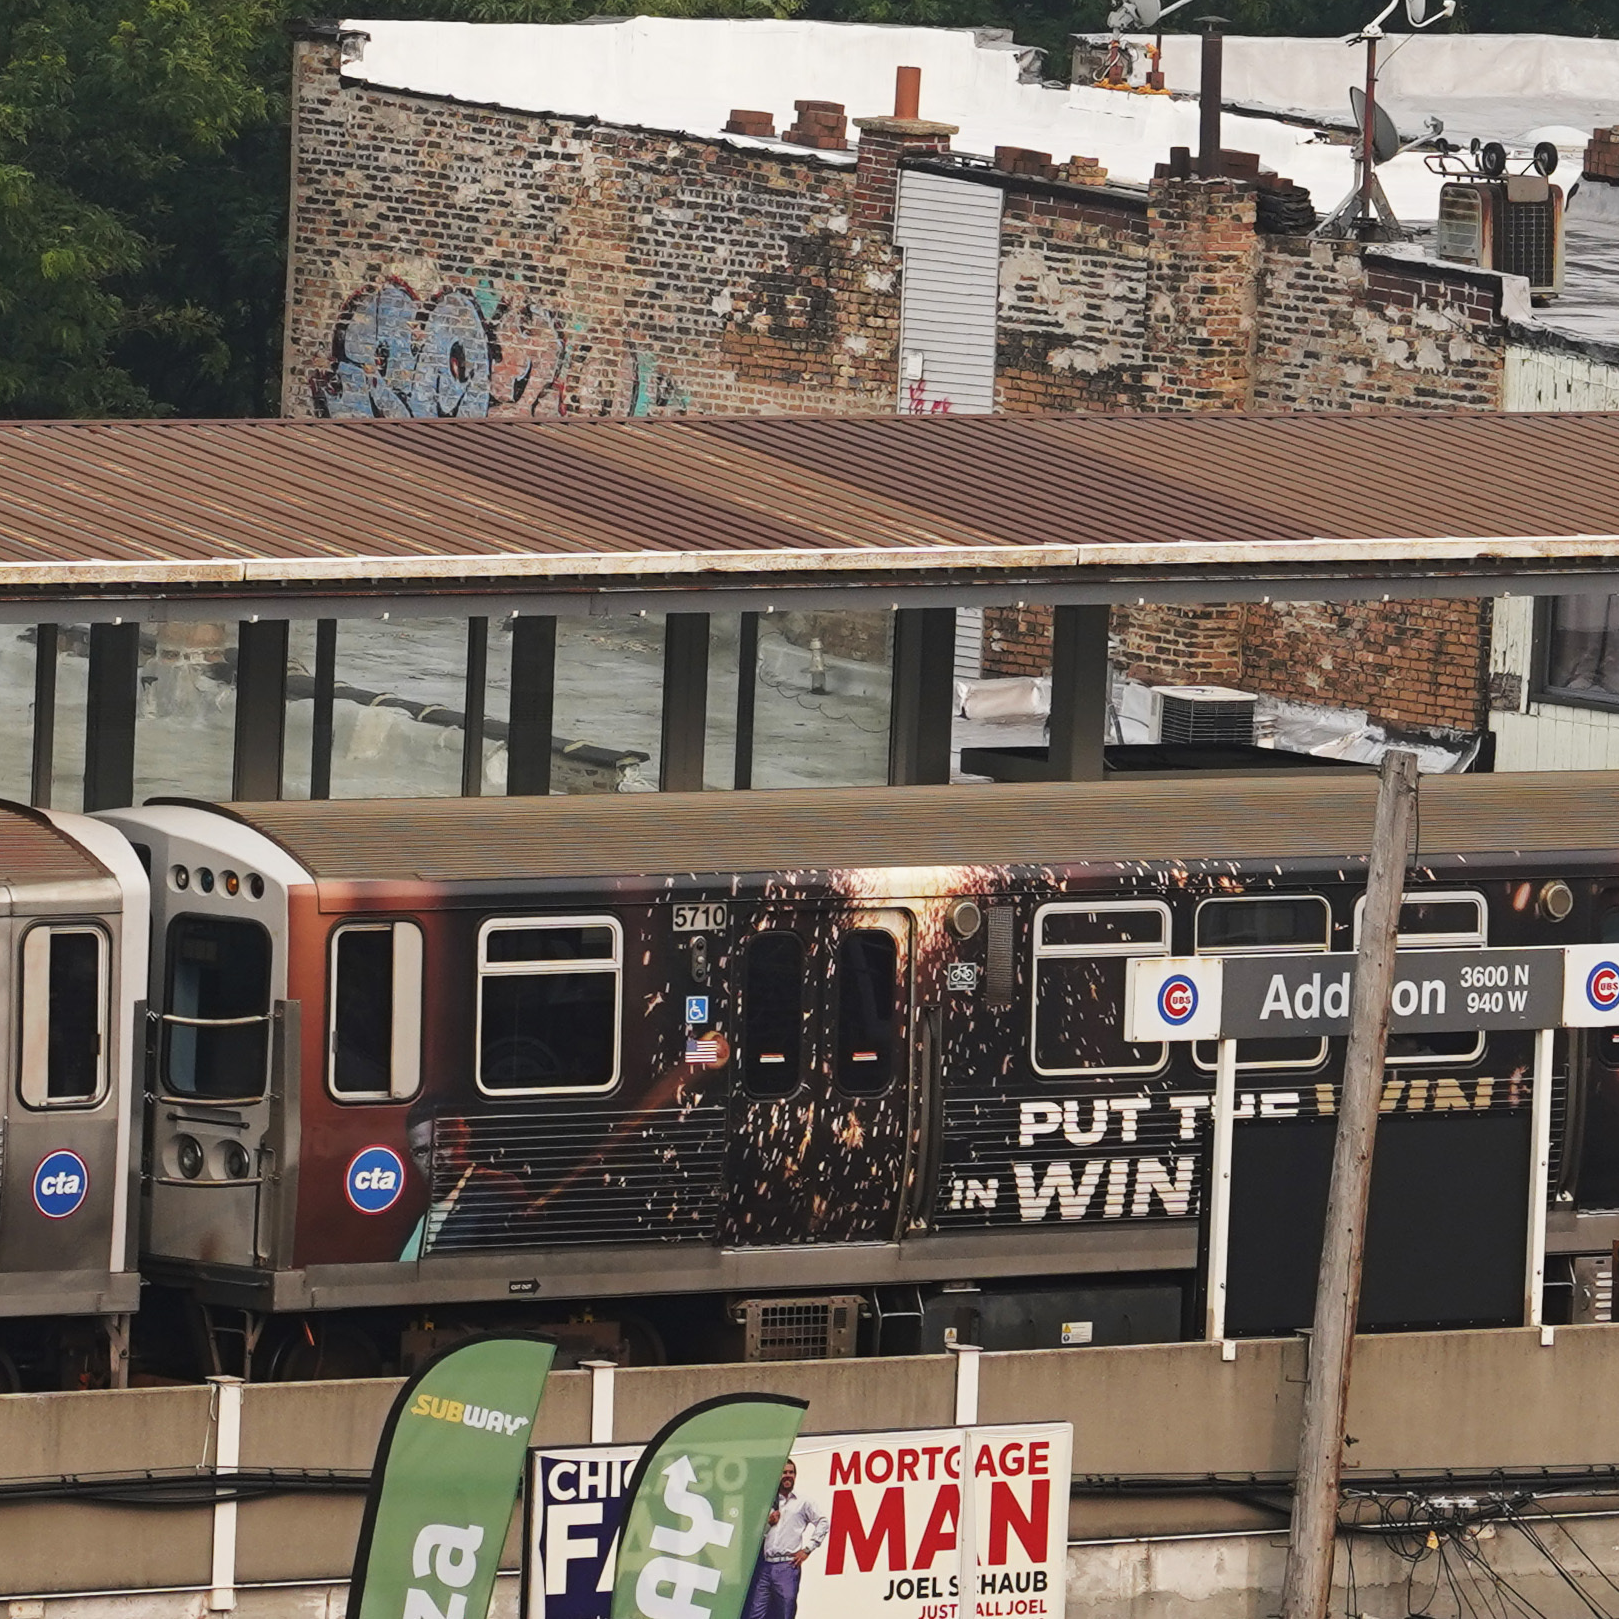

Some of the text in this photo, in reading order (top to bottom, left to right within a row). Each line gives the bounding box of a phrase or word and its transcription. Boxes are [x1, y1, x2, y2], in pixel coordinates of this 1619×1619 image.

[674, 905, 726, 928] 5710
[1460, 964, 1530, 989] 3600 N
[1259, 973, 1446, 1021] Addon
[1467, 989, 1528, 1014] 940 W
[1019, 1097, 1152, 1147] PUT
[40, 1171, 79, 1196] cta
[354, 1168, 395, 1192] cta
[949, 1178, 1000, 1210] IN
[411, 1394, 530, 1437] SUBWAY
[829, 1441, 1051, 1486] MORTGAGE
[825, 1479, 1051, 1575] MAN
[883, 1571, 1048, 1601] JOEL SHAUB
[918, 1599, 1048, 1619] JUST ALL JOEL
